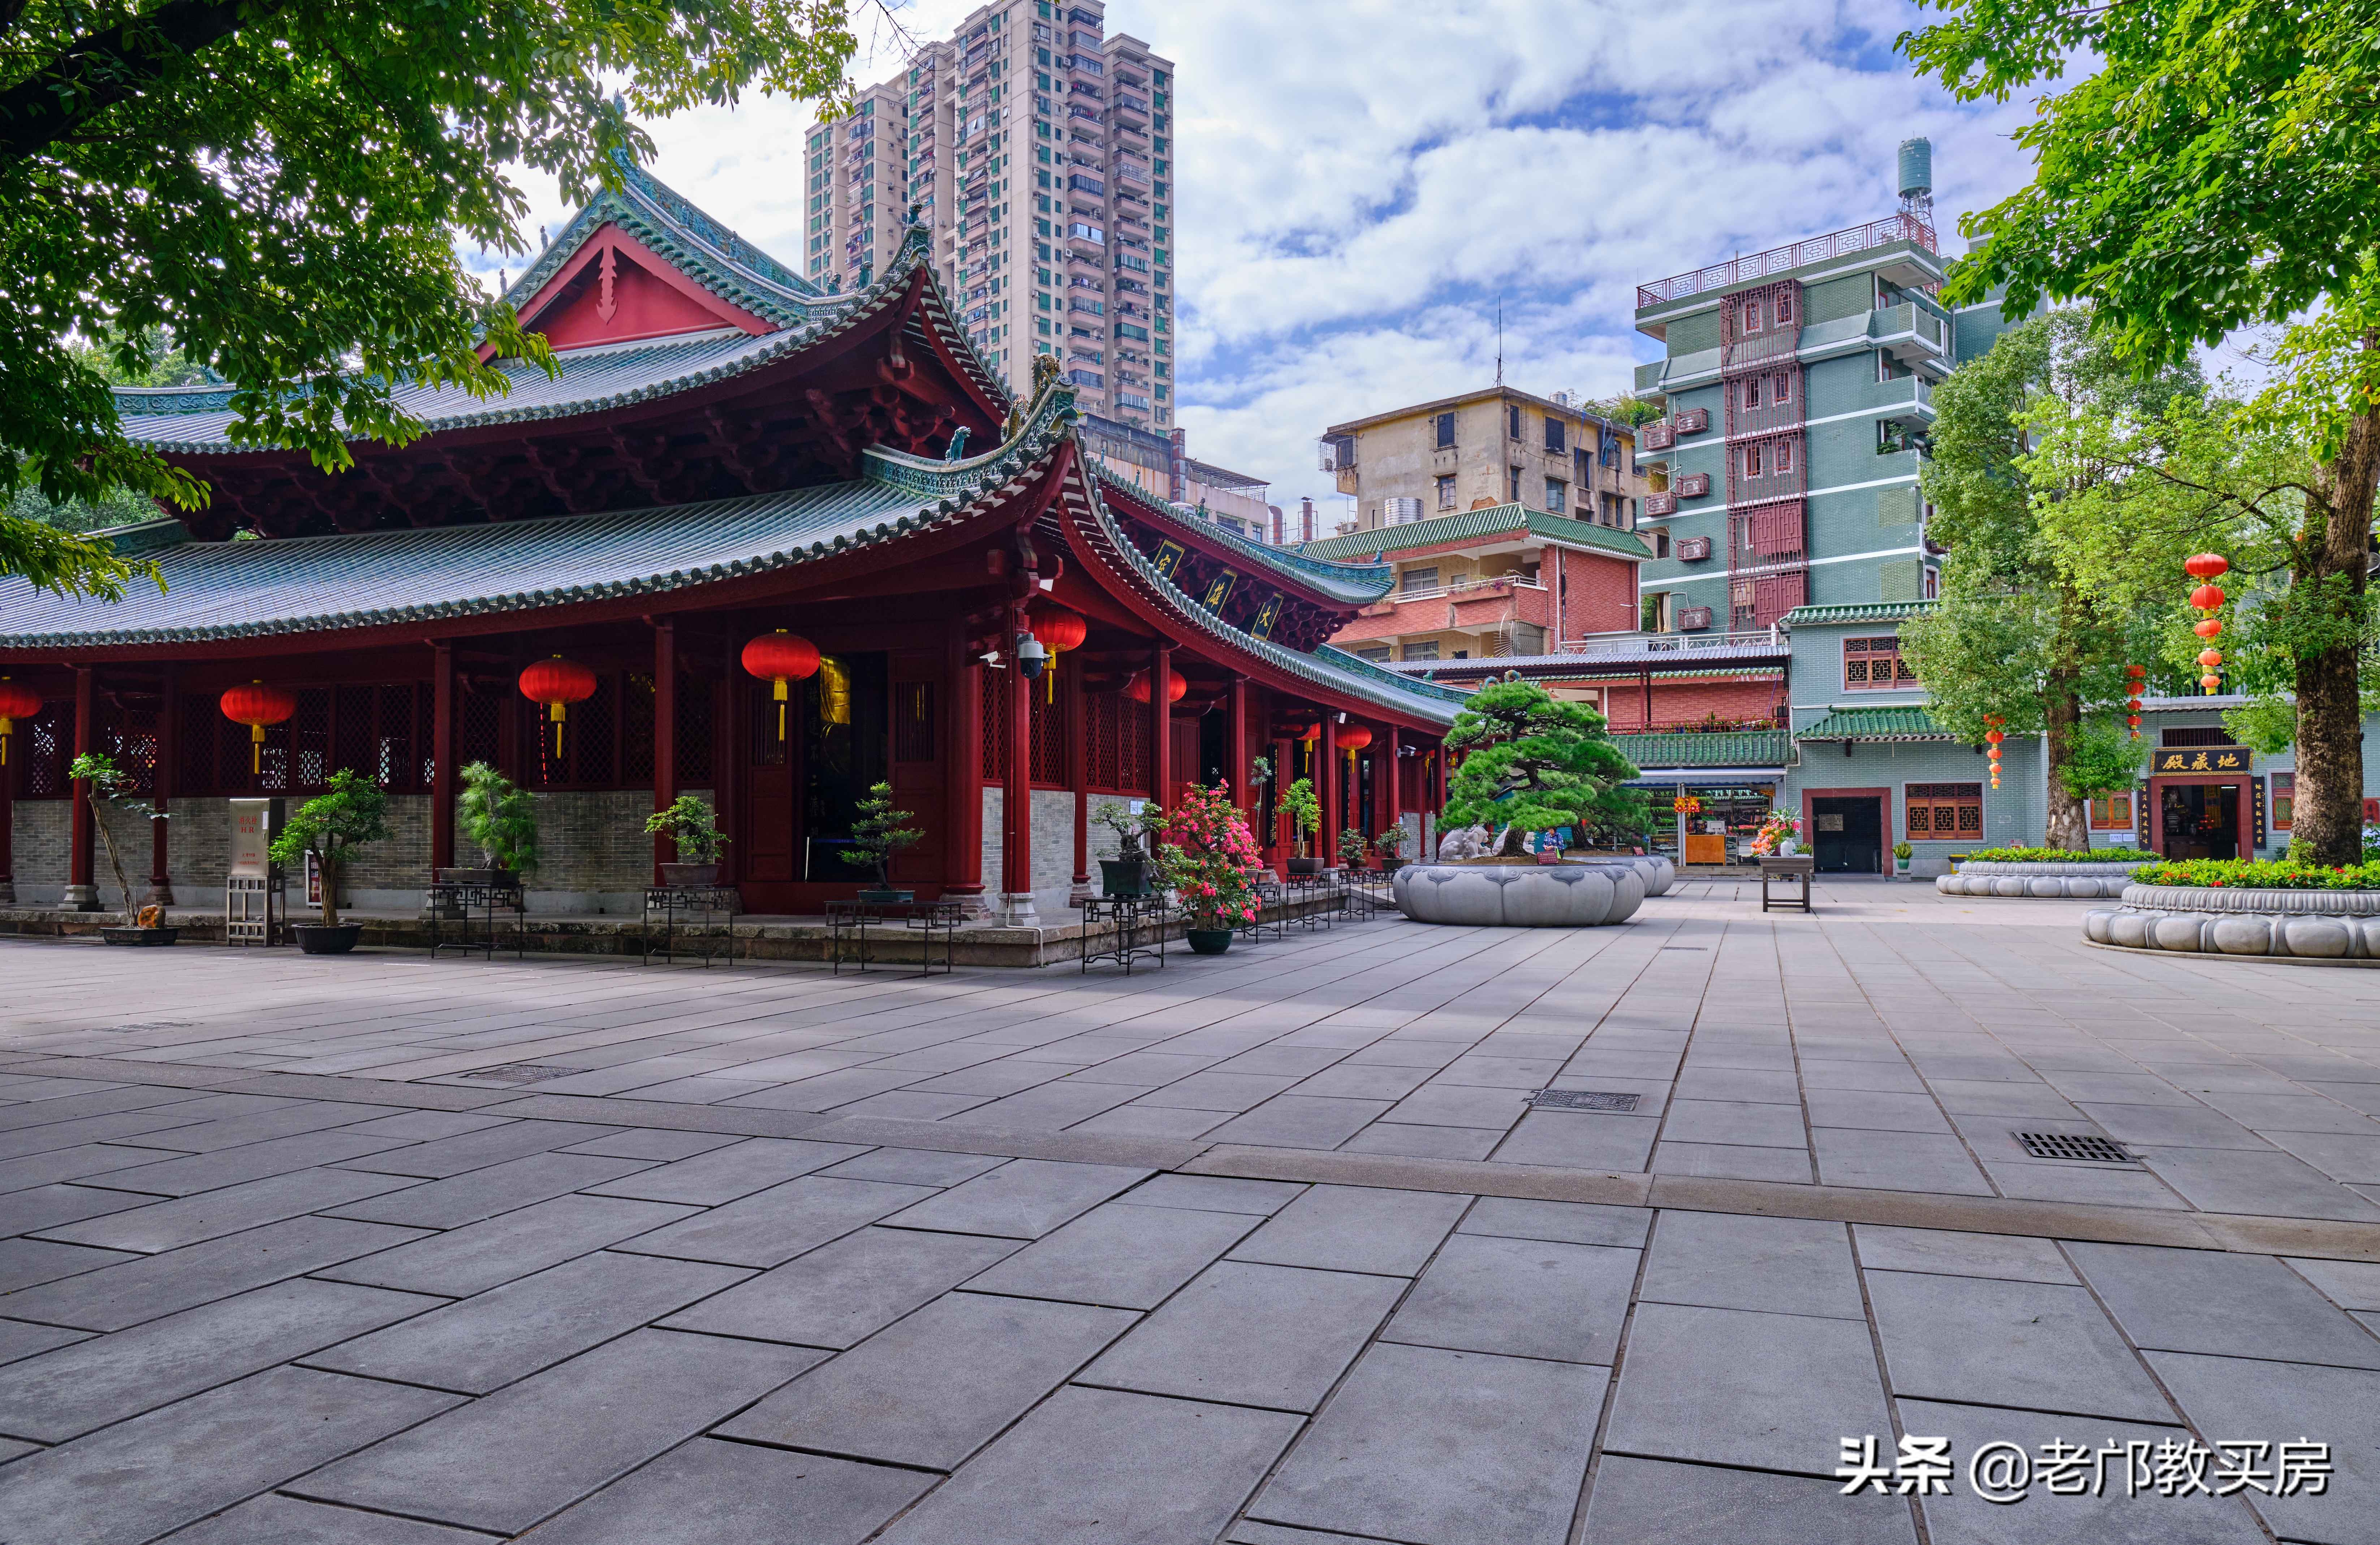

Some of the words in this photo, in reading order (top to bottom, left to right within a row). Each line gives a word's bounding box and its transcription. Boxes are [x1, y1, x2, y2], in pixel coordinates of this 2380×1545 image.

[1259, 605, 1271, 627] 大
[2163, 752, 2239, 771] 地藏殿
[239, 815, 257, 824] 消火栓
